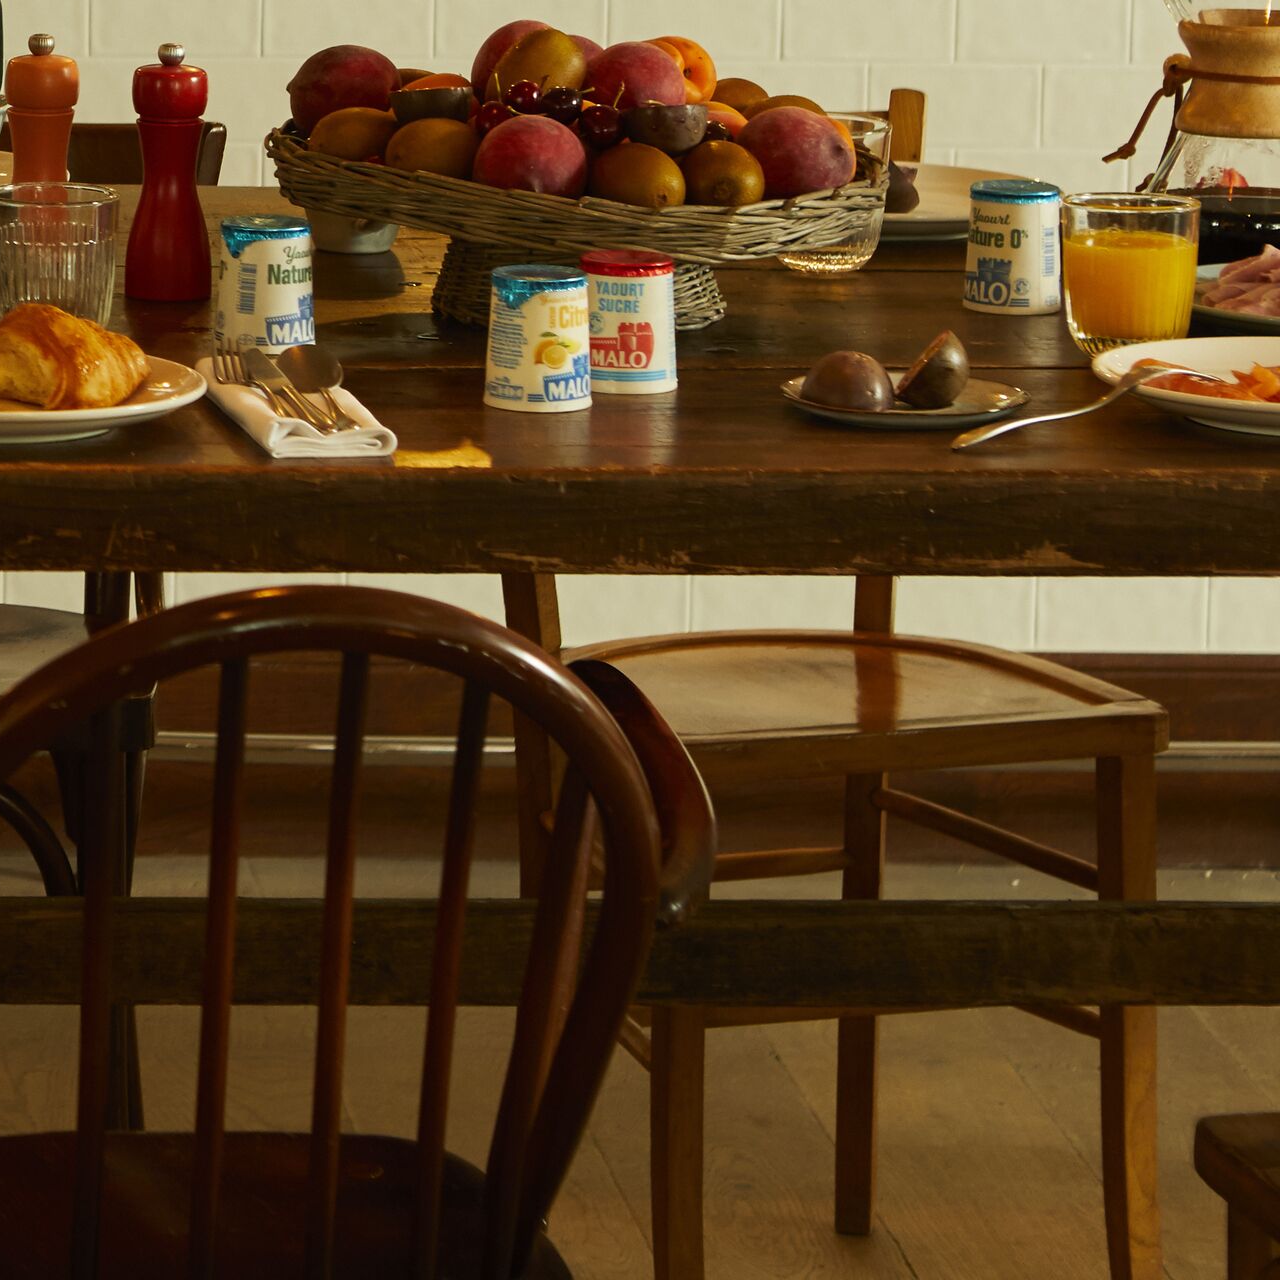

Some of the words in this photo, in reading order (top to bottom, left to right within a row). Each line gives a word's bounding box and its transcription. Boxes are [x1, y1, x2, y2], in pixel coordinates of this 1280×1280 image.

[972, 207, 1011, 225] Yaourt
[969, 227, 1004, 248] ature
[595, 281, 645, 297] YAOURT
[271, 318, 315, 345] MALO
[591, 349, 647, 368] MALO
[548, 375, 591, 402] MALO
